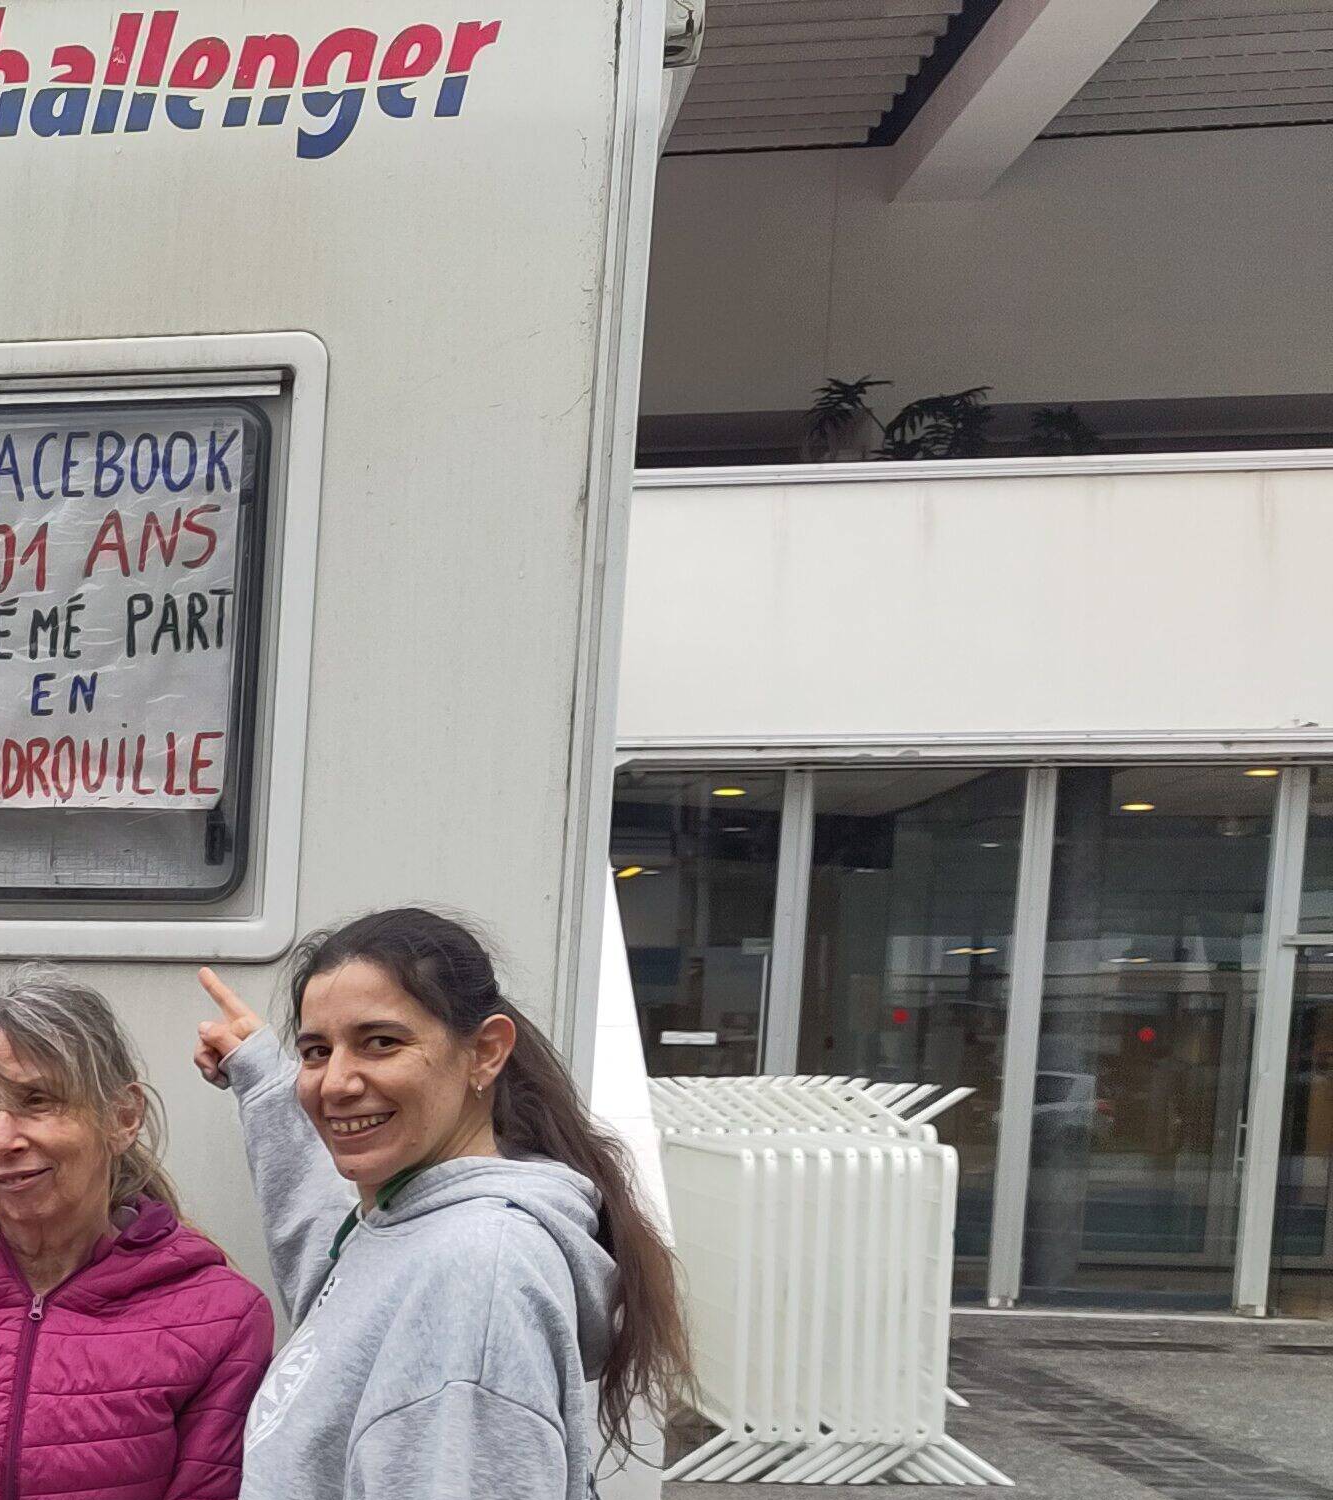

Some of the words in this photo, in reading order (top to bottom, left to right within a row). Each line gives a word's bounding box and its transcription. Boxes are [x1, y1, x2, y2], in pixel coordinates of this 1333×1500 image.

[84, 504, 221, 578] ANS
[126, 587, 235, 658] PART
[30, 671, 99, 716] EN
